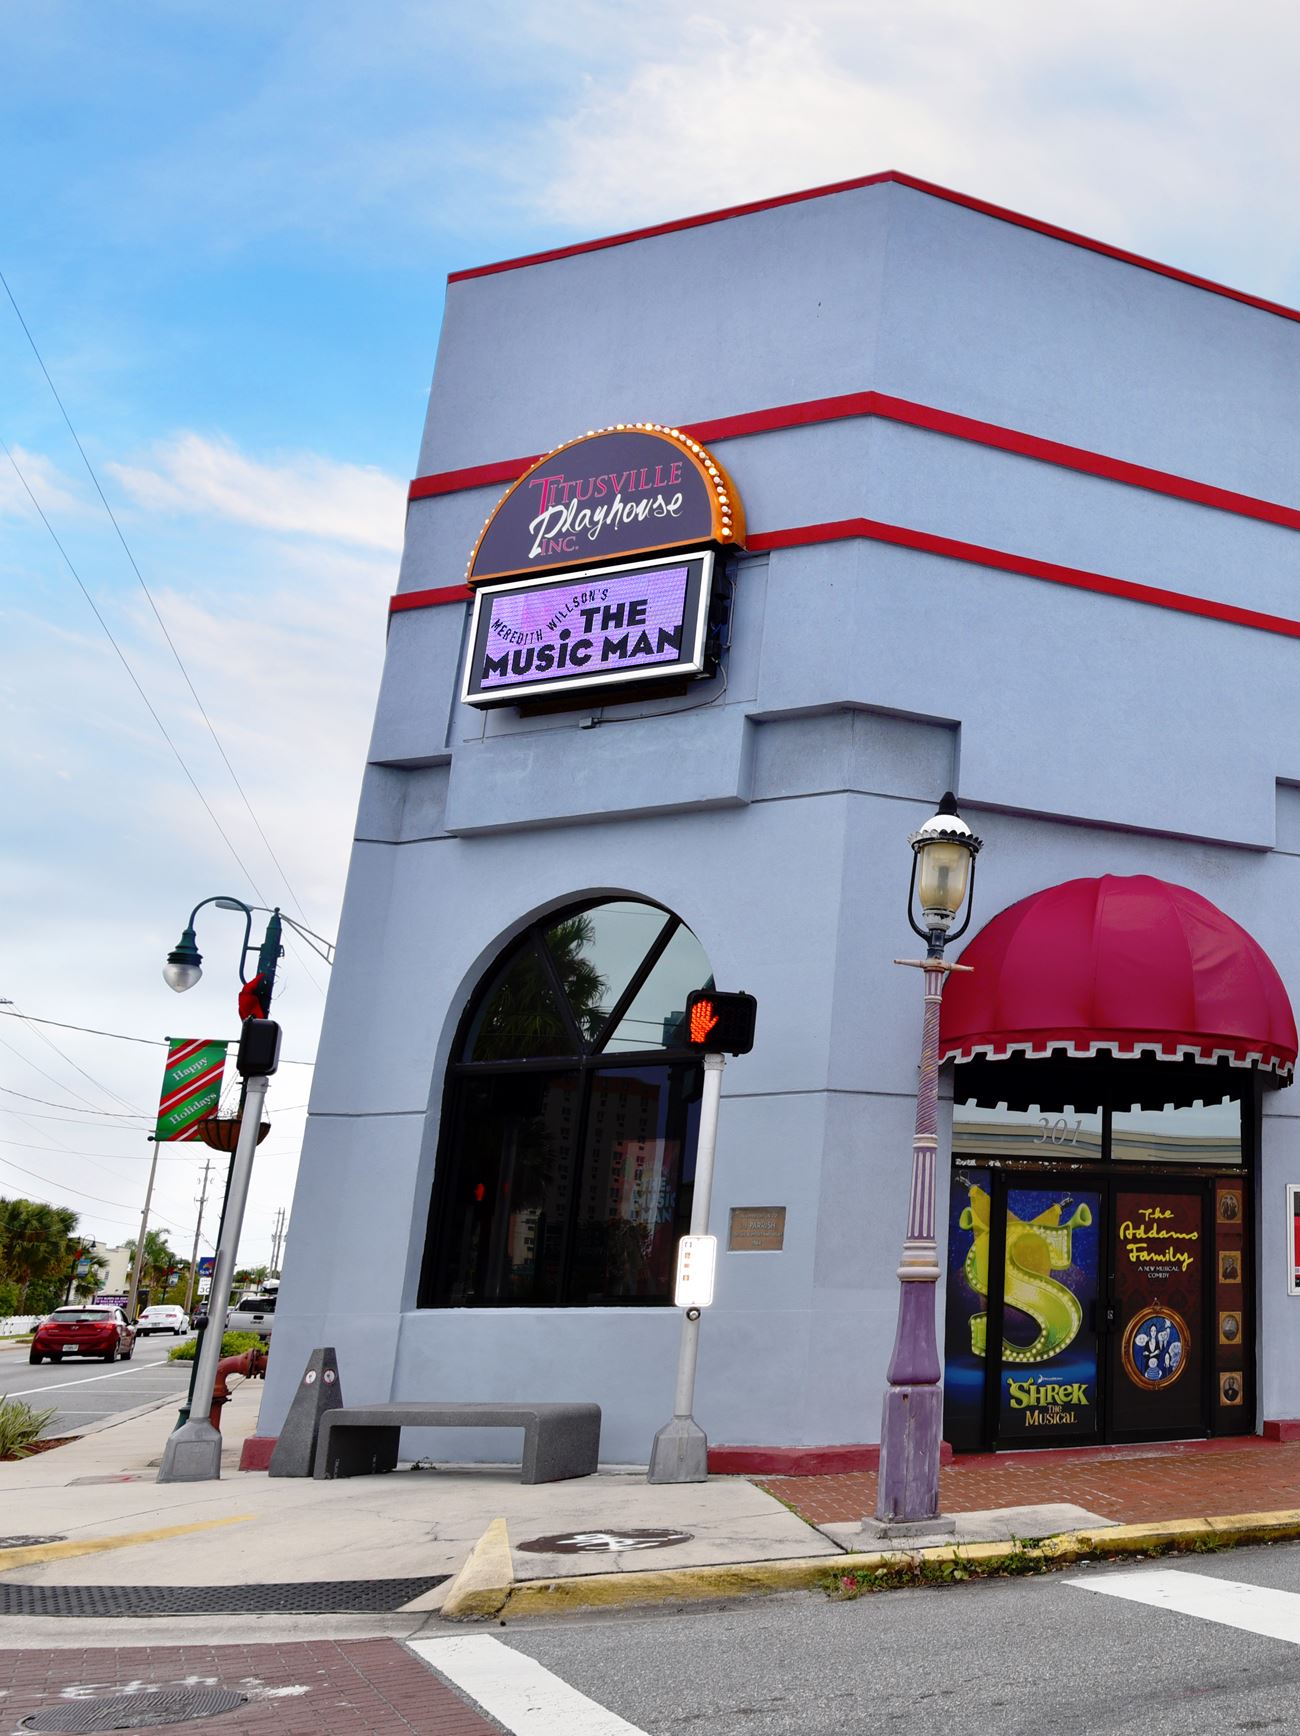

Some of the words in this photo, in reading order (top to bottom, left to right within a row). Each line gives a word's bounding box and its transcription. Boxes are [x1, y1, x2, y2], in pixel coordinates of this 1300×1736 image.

[529, 461, 683, 515] TITUSVILLE
[528, 493, 683, 559] Playhouse
[540, 536, 579, 556] INC.
[491, 618, 543, 646] MEREDITH
[546, 589, 610, 632] WILLSON'S
[580, 599, 649, 634] THE
[601, 625, 682, 662] MAN
[173, 1057, 208, 1081] Happy
[169, 1093, 217, 1125] Holidays
[1033, 1117, 1082, 1145] 301
[1138, 1207, 1175, 1221] The
[1120, 1221, 1198, 1240] Addams
[1126, 1243, 1194, 1272] Family
